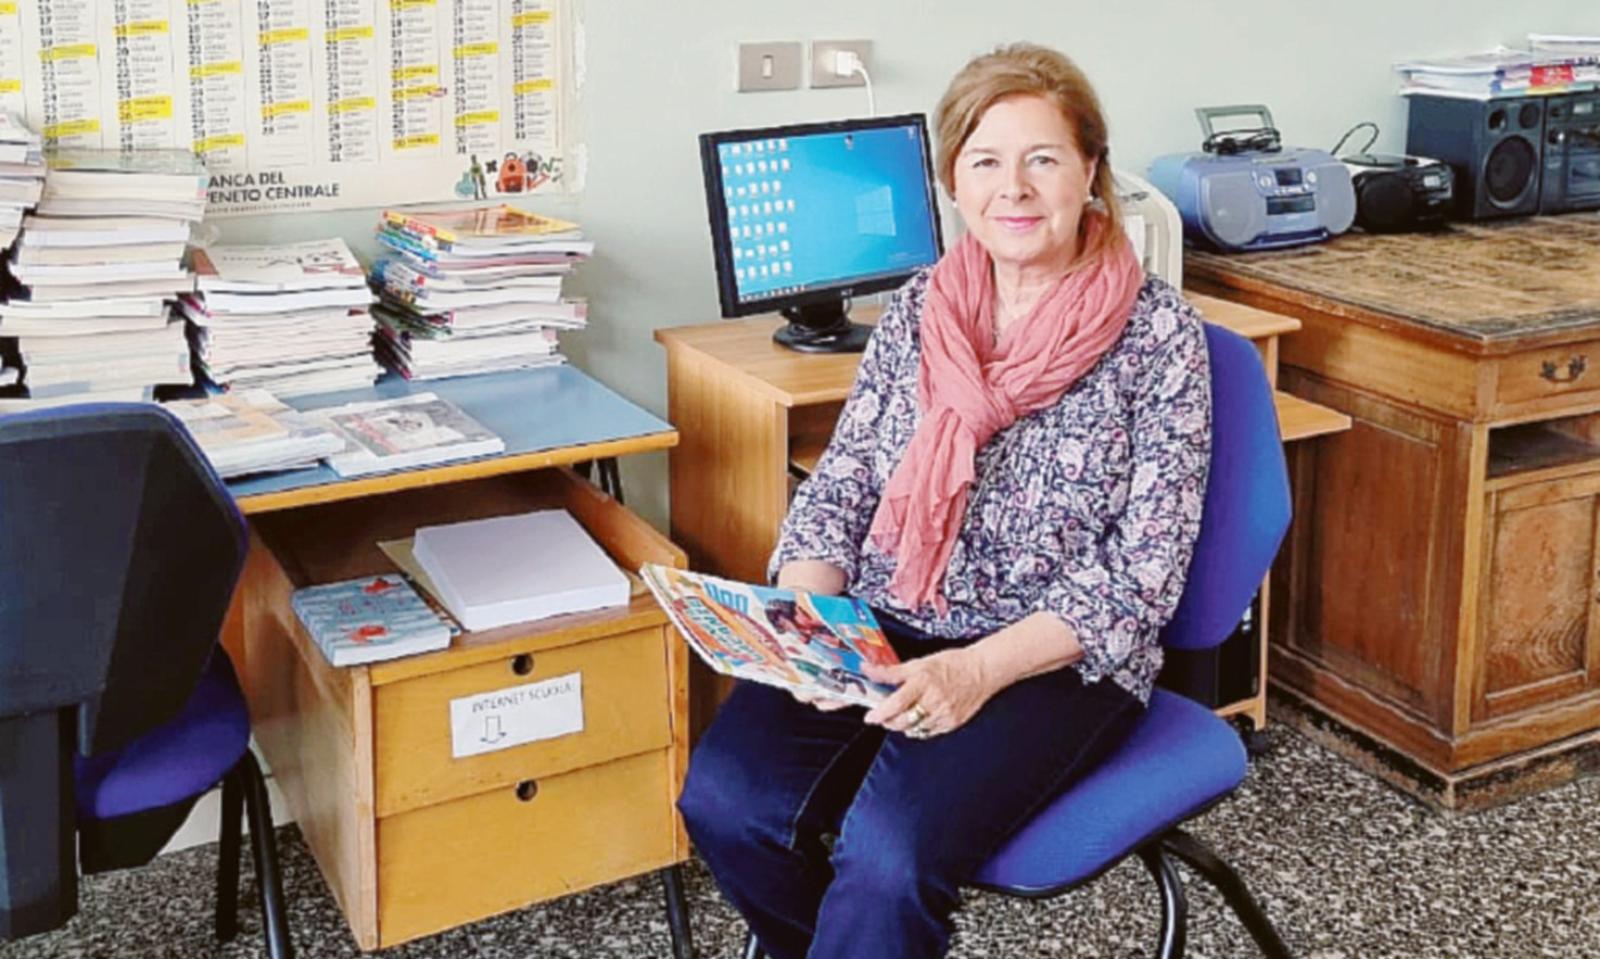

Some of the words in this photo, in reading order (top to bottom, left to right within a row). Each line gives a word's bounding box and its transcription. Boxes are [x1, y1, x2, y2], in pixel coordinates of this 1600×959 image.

[207, 174, 255, 188] ANCA
[259, 172, 285, 185] DEL
[266, 184, 339, 200] CENTRALE
[472, 691, 525, 713] INTERNET
